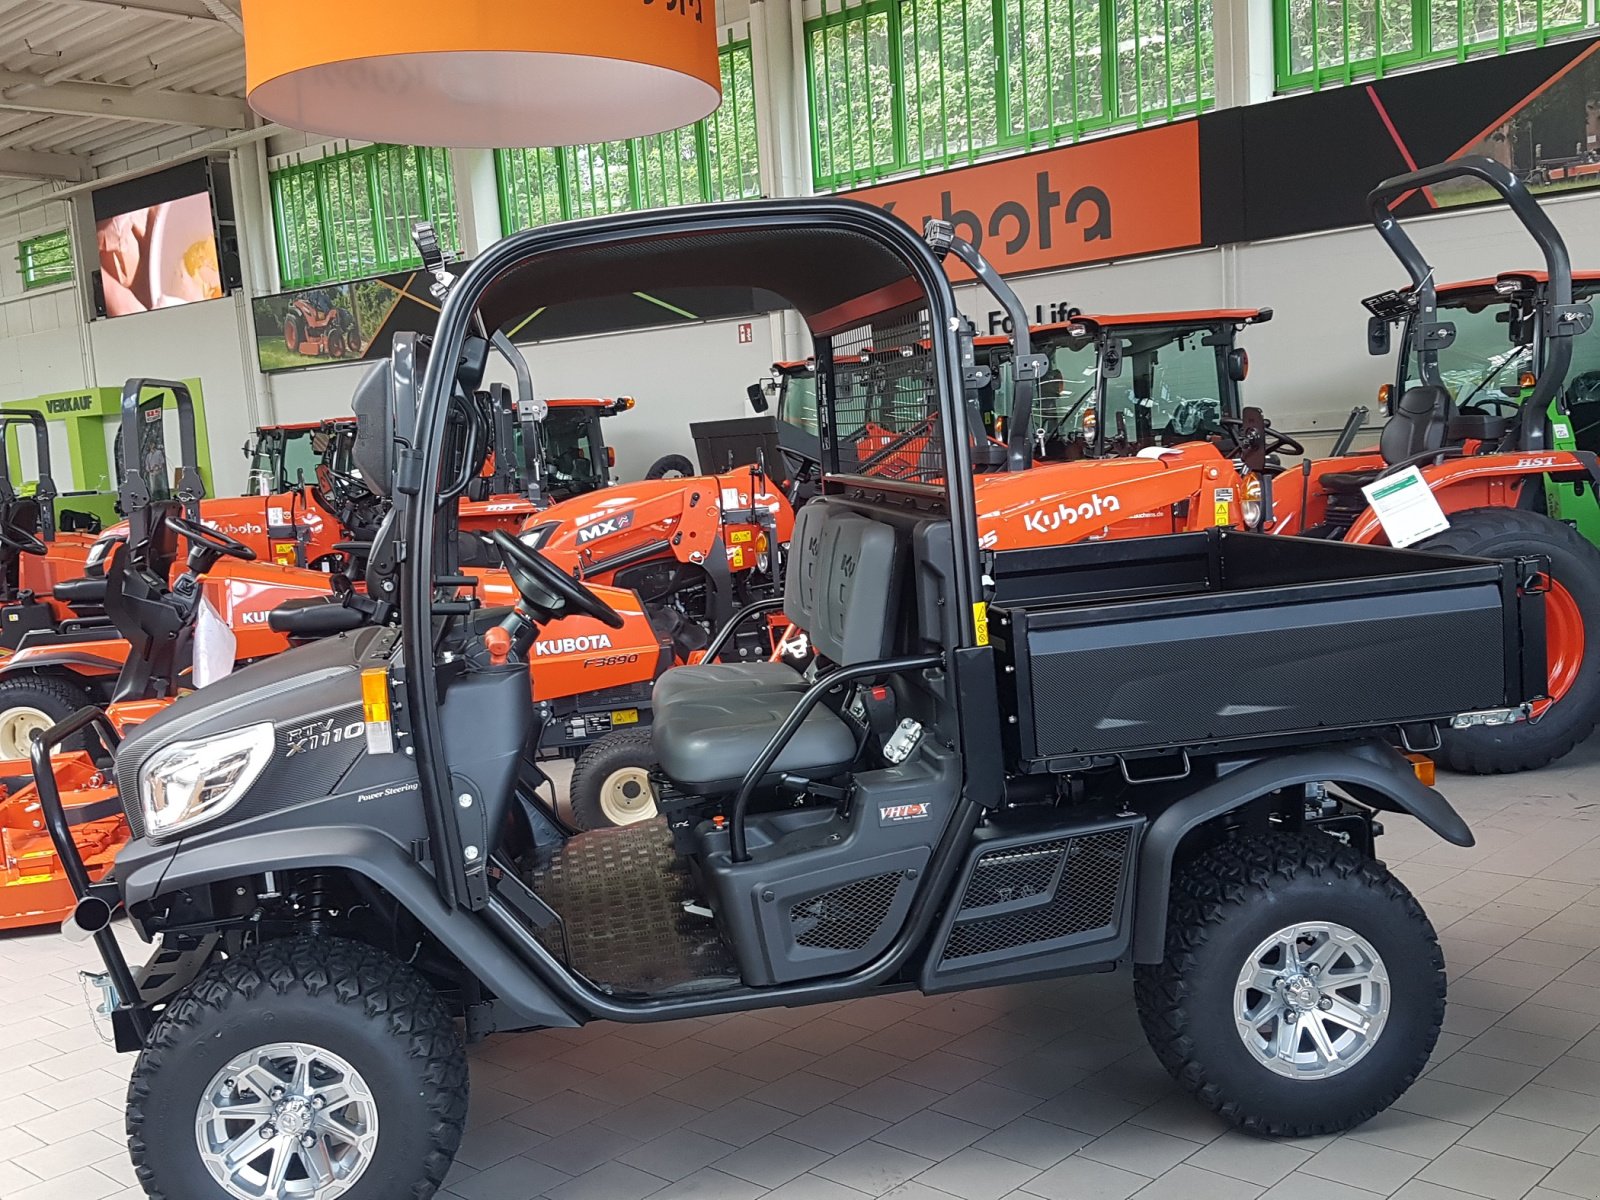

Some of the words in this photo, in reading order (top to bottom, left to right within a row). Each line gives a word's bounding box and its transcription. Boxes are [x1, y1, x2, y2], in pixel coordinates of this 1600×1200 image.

[882, 171, 1112, 256] bota
[988, 310, 1014, 335] Fo
[46, 395, 93, 414] VERKAUF
[1518, 456, 1556, 467] HST
[1024, 494, 1120, 532] Kubota
[579, 519, 617, 542] MX
[536, 634, 612, 656] KUBOTA
[584, 654, 638, 668] F3890
[286, 722, 364, 757] X1110
[287, 719, 334, 741] RTV
[358, 791, 384, 802] Power
[384, 783, 419, 796] Steering
